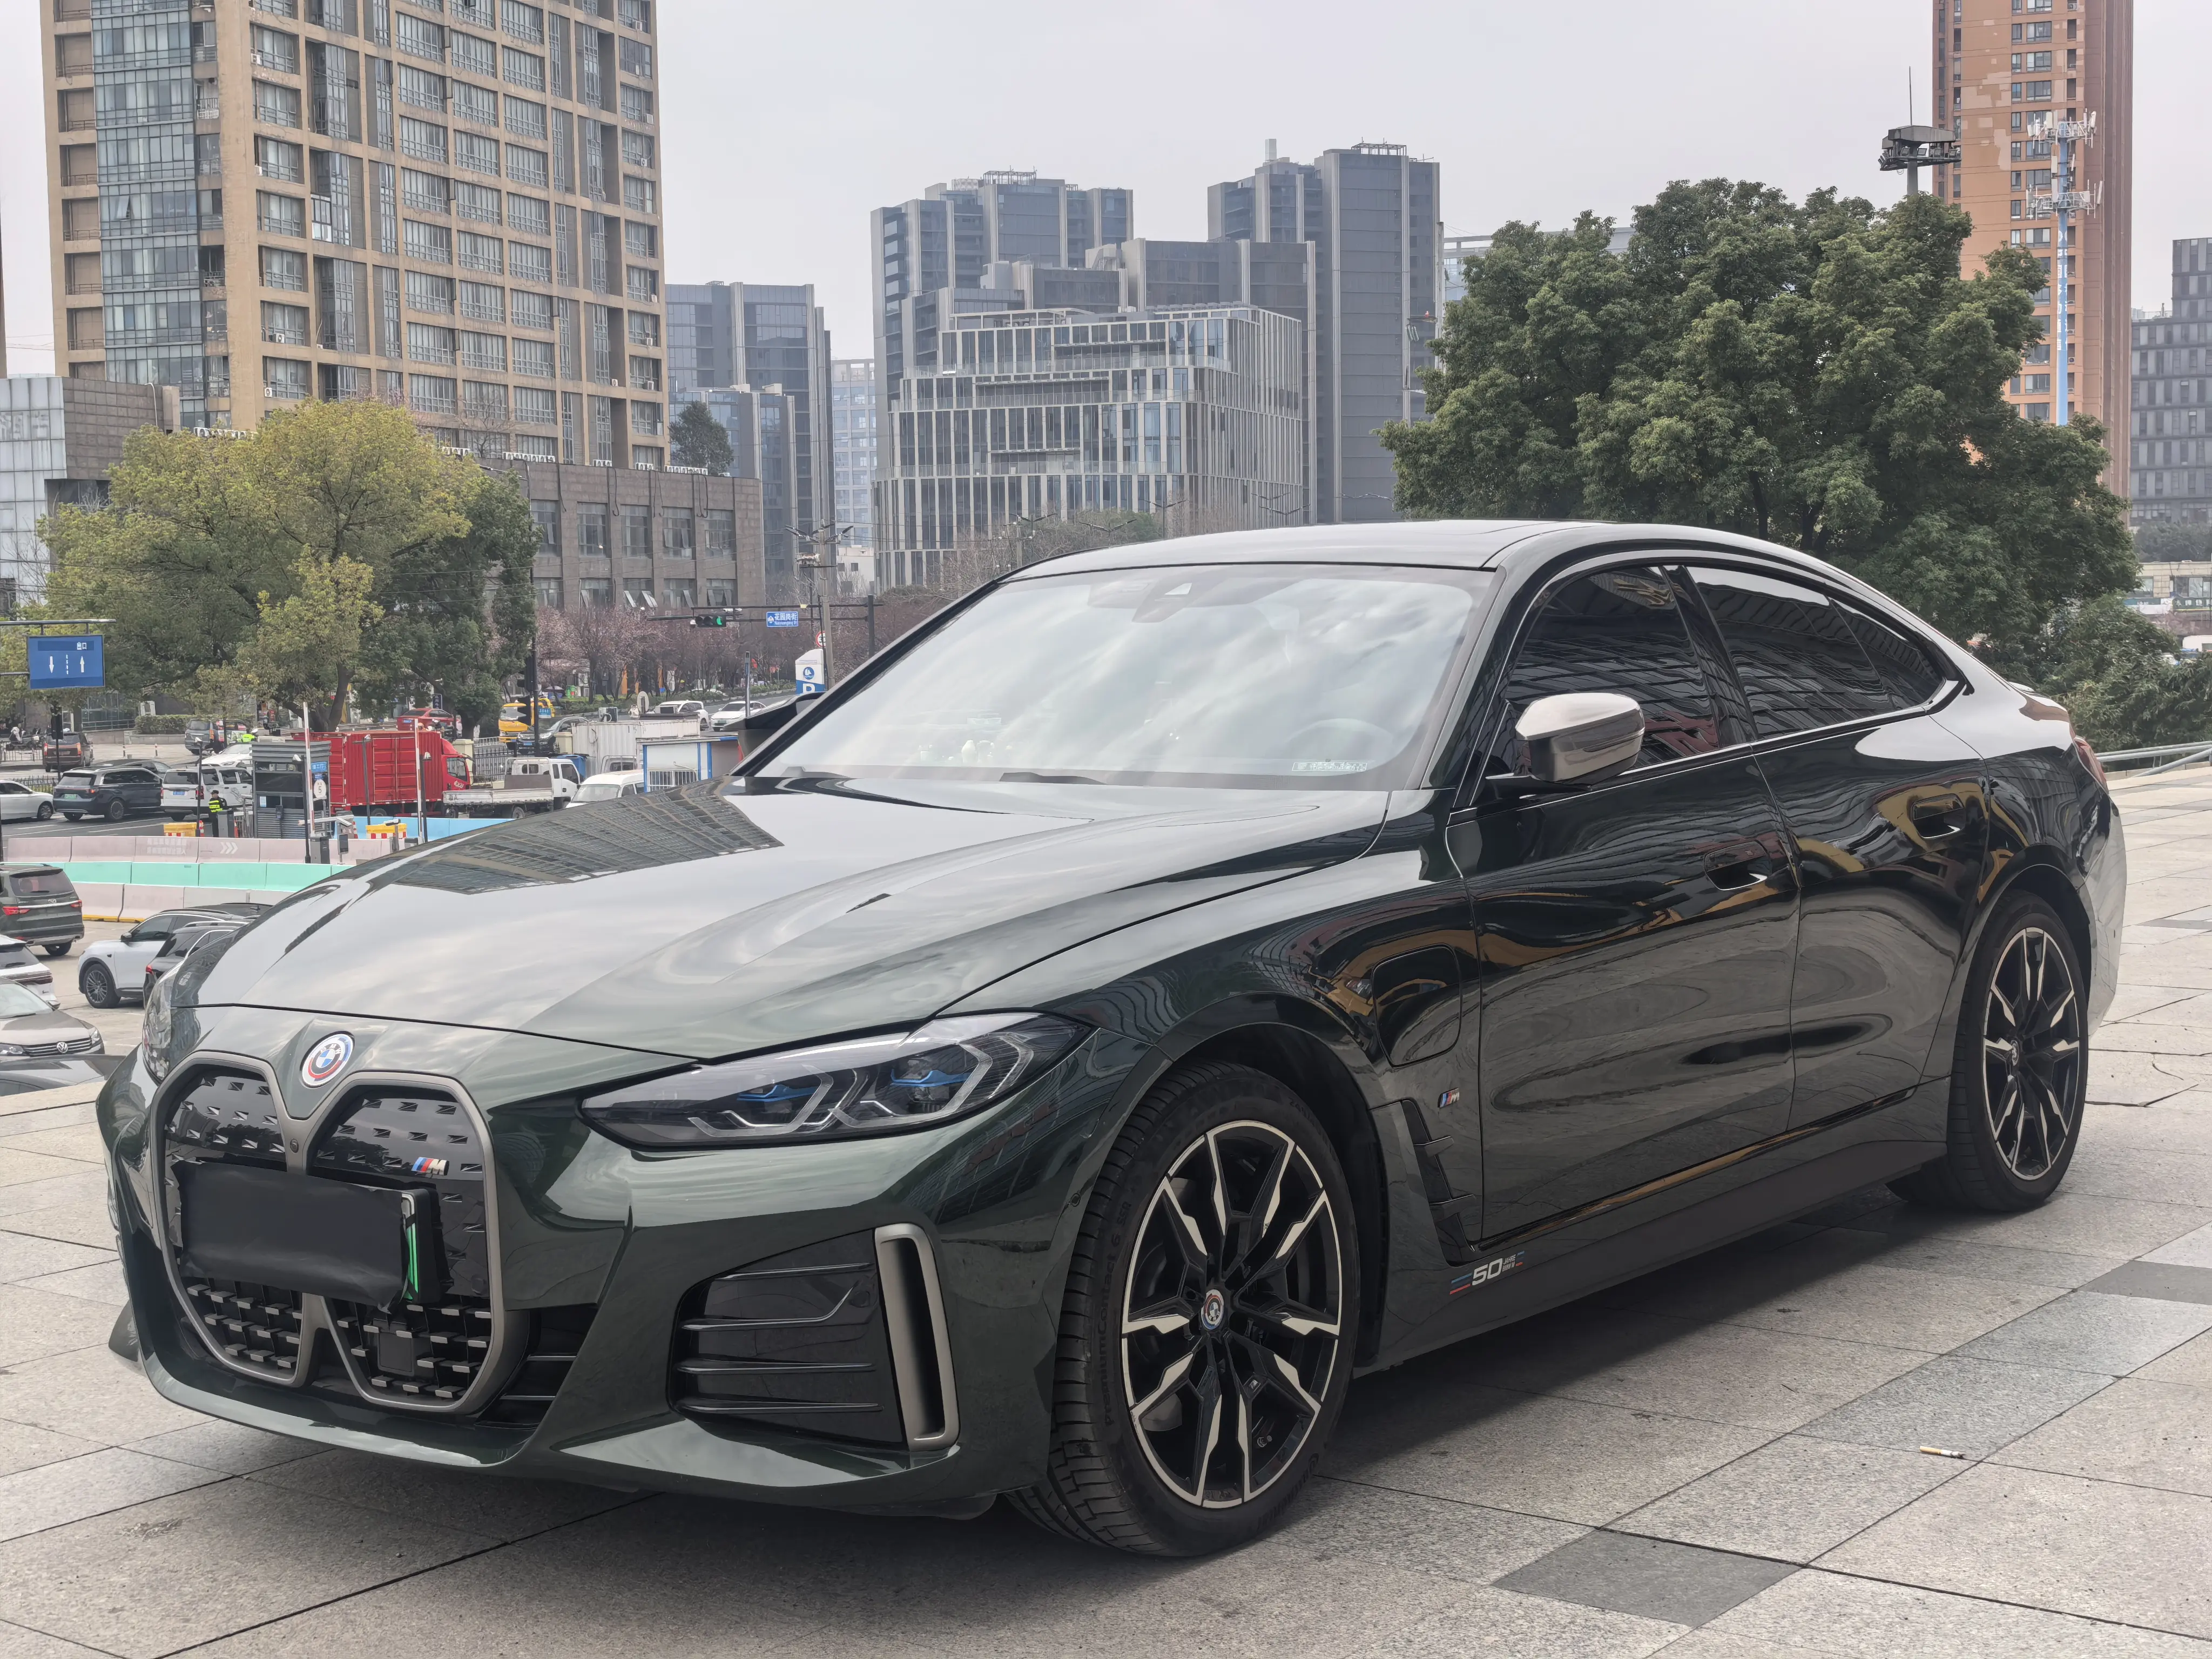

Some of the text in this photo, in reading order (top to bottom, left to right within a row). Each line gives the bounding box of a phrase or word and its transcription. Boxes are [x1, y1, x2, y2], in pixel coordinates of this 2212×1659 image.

[802, 683, 815, 694] P
[1503, 1254, 1516, 1265] JAHRE
[1472, 1258, 1503, 1286] 50
